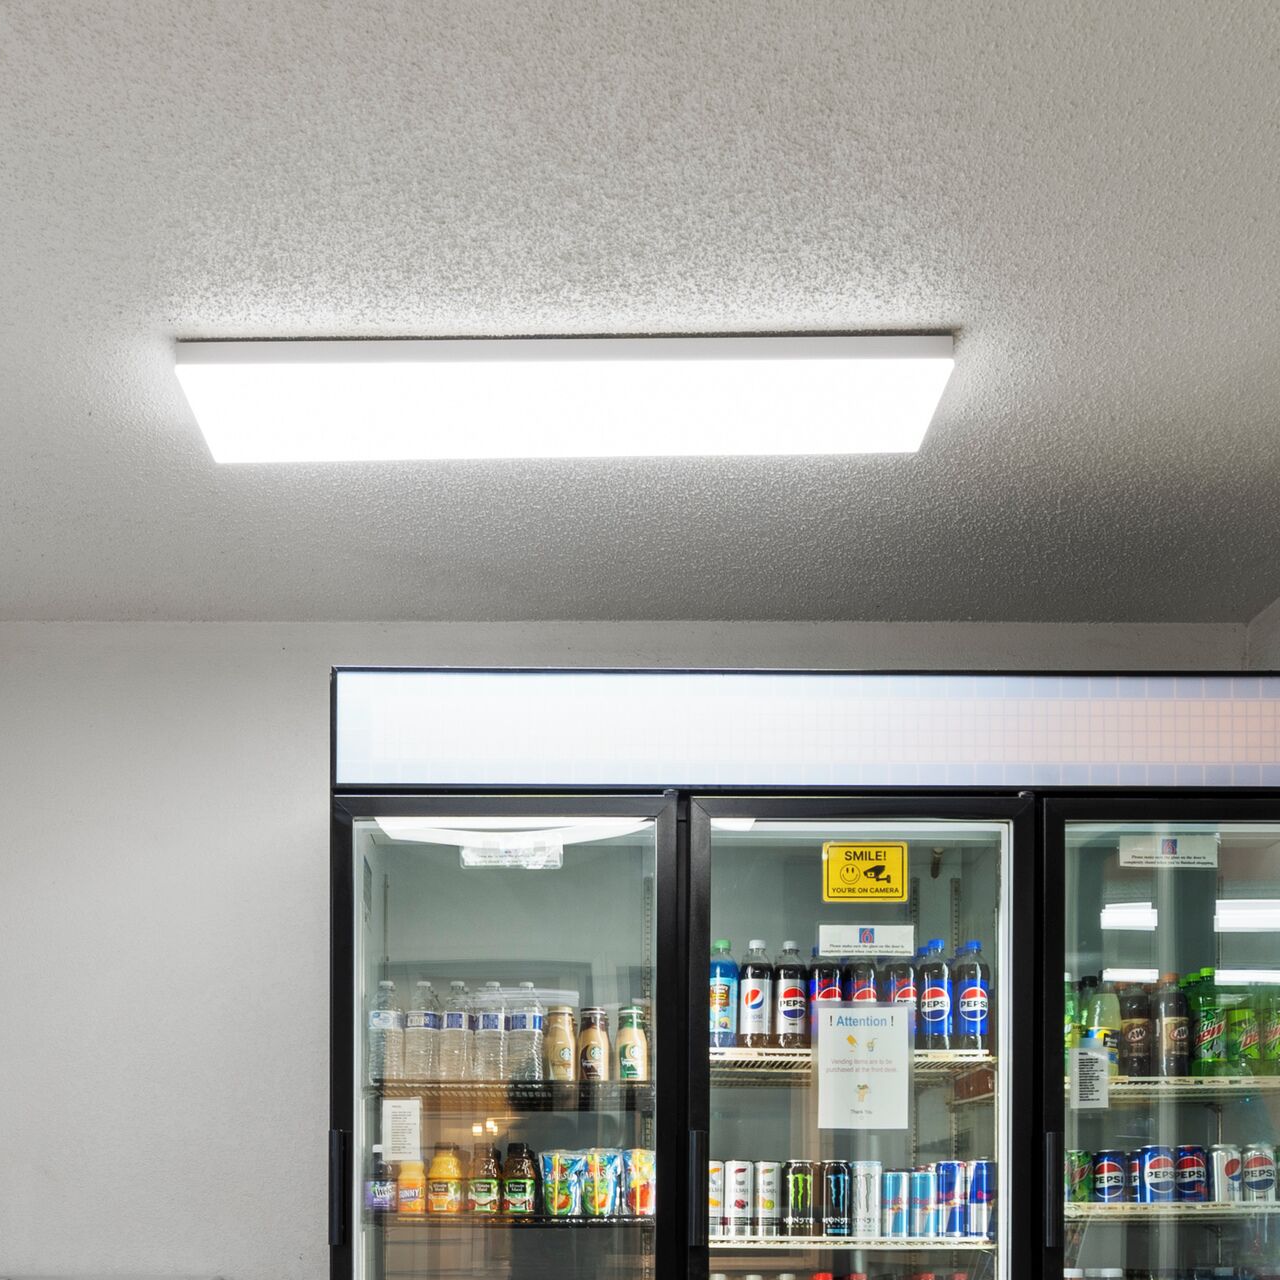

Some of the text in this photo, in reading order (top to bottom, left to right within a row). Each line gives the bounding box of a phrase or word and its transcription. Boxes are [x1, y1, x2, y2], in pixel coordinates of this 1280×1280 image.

[845, 851, 887, 861] SMILE!
[836, 1016, 887, 1027] Attention
[1243, 1170, 1276, 1178] PEPSI
